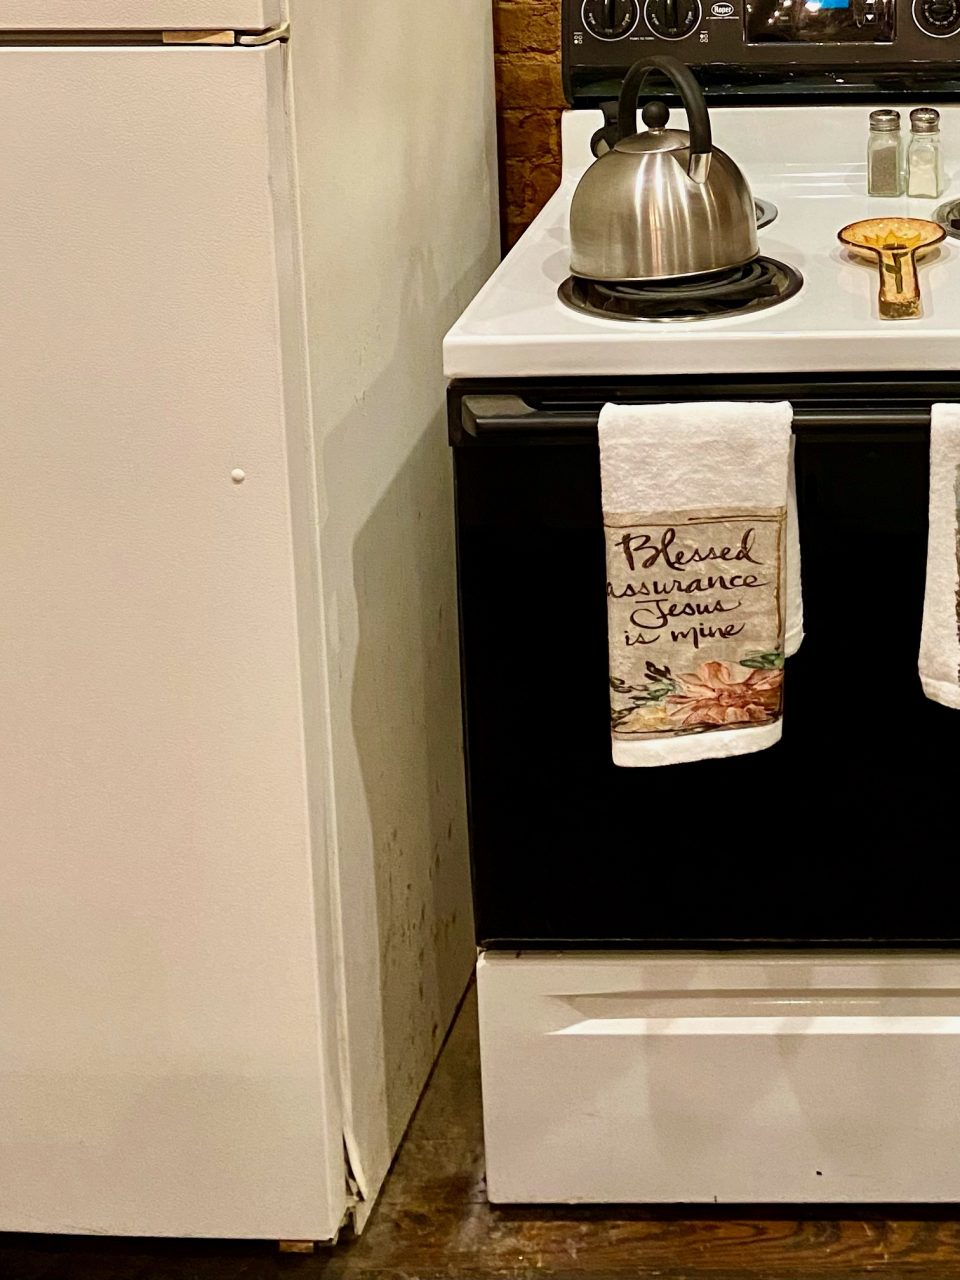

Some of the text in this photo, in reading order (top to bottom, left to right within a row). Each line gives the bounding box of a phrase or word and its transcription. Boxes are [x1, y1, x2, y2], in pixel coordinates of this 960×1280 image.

[713, 5, 732, 14] Roper
[615, 527, 763, 572] Blessed
[629, 599, 742, 629] Jesus
[624, 622, 746, 649] is mine
